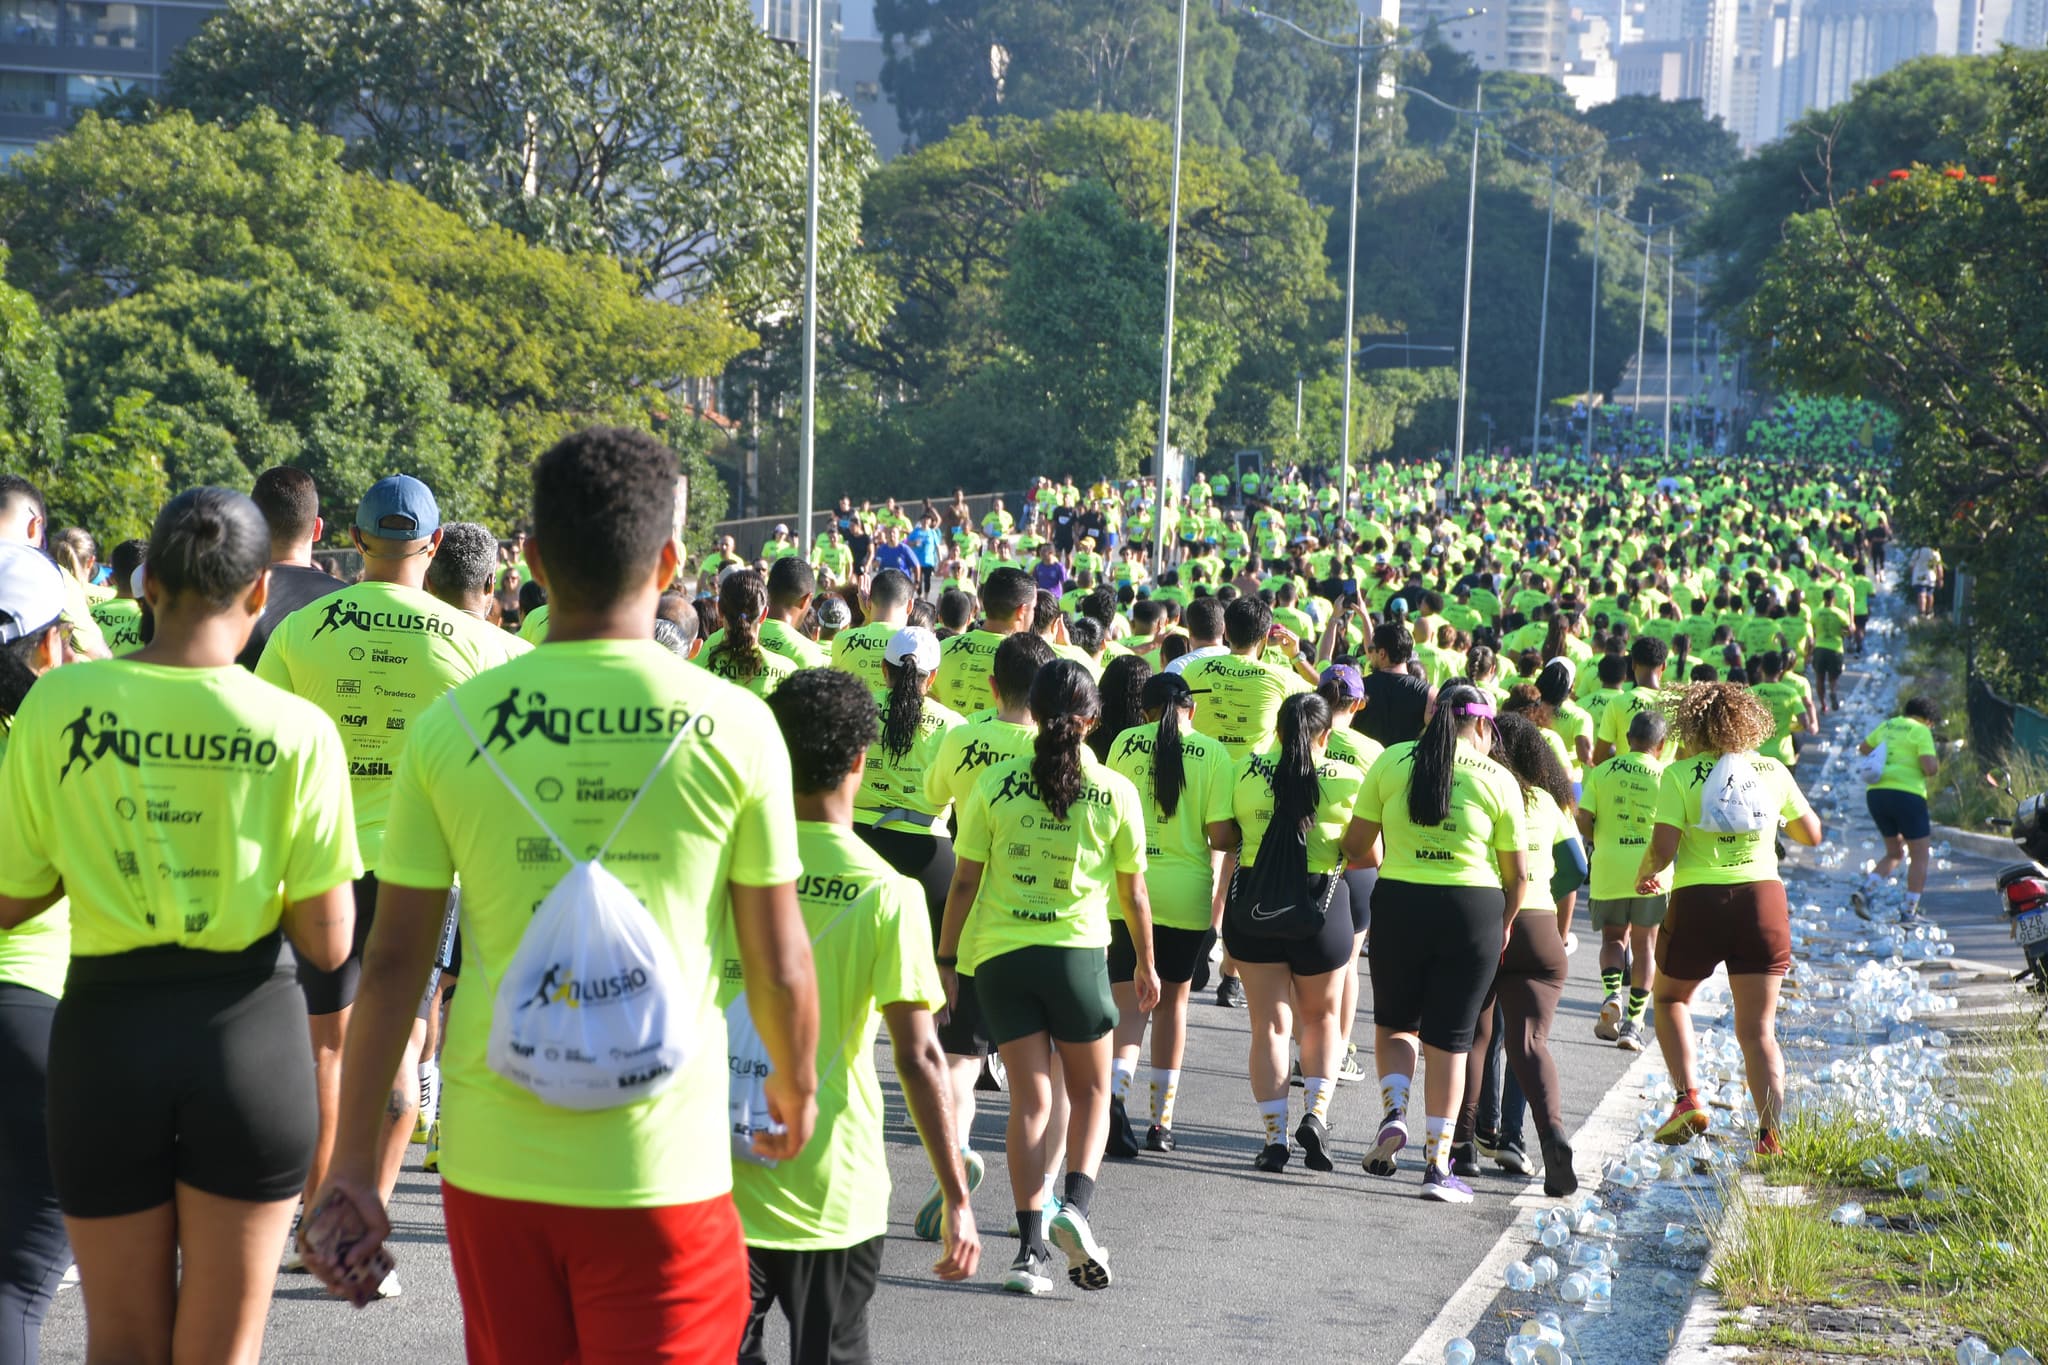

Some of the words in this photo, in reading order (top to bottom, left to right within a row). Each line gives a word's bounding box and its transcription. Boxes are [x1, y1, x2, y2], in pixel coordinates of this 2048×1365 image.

[371, 654, 408, 664] ENERGY
[384, 689, 416, 698] bradesco
[348, 761, 393, 775] RASIL
[146, 809, 203, 823] ENERGY
[1040, 822, 1071, 833] ENERGY
